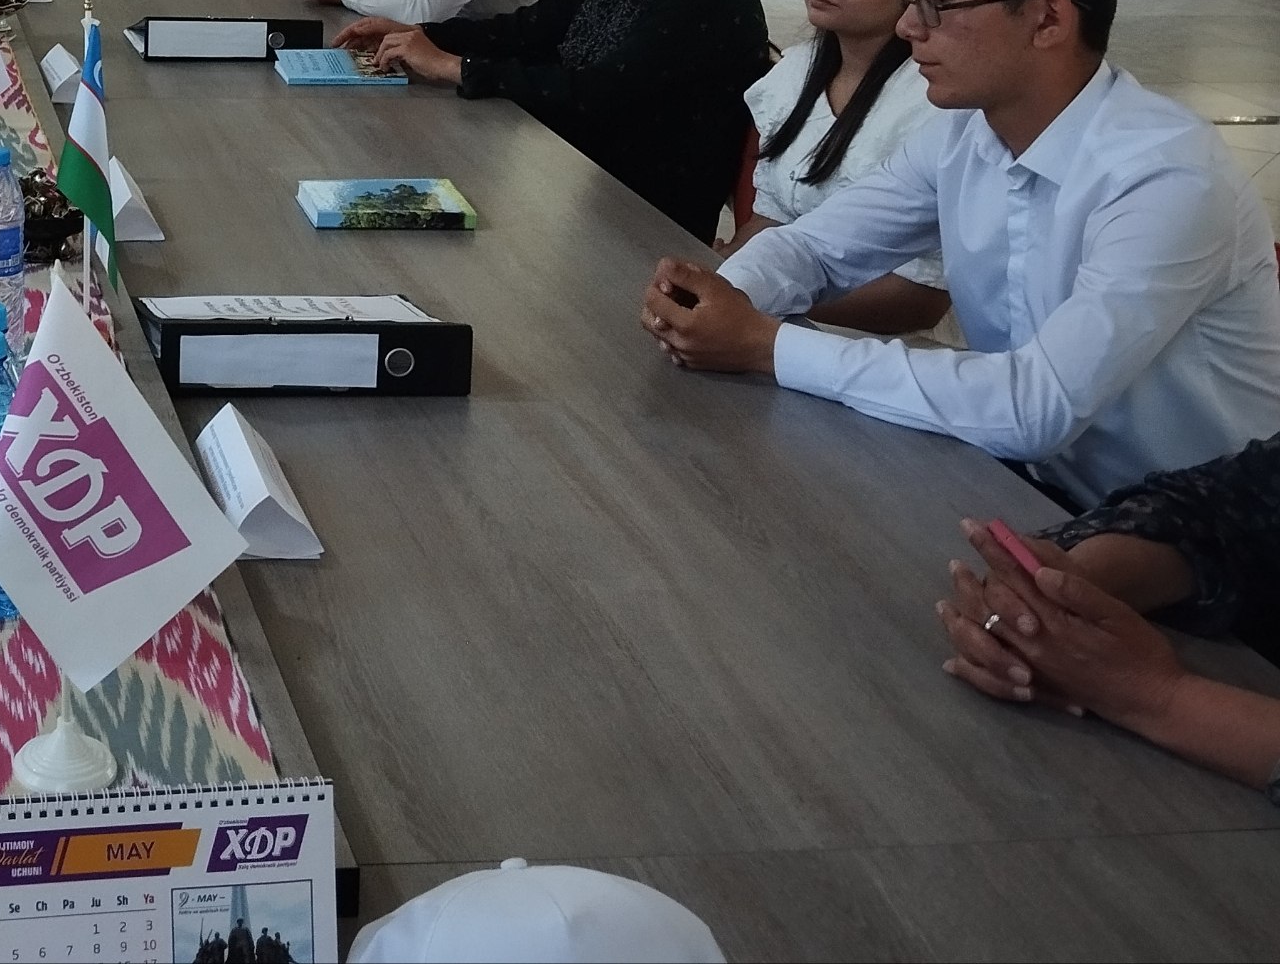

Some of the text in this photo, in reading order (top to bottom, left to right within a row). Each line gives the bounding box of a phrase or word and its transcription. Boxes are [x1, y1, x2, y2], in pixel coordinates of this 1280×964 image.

[47, 353, 98, 421] O'zbekiston
[1, 387, 142, 560] XDP
[5, 502, 48, 562] demokratik
[42, 560, 80, 604] partiyasi
[106, 841, 155, 861] MAY
[220, 826, 297, 860] XDP
[9, 903, 20, 913] Se
[36, 901, 48, 911] Ch
[63, 899, 75, 910] Pa
[91, 897, 101, 908] Ju
[117, 895, 129, 906] Sh
[143, 893, 155, 904] Ya
[197, 893, 218, 902] MAY
[93, 920, 153, 935] 1 2 3
[12, 949, 19, 960] 5
[39, 947, 46, 958] 6
[66, 945, 73, 956] 7
[93, 943, 101, 954] 8
[120, 941, 127, 952] 9
[143, 939, 156, 951] 10
